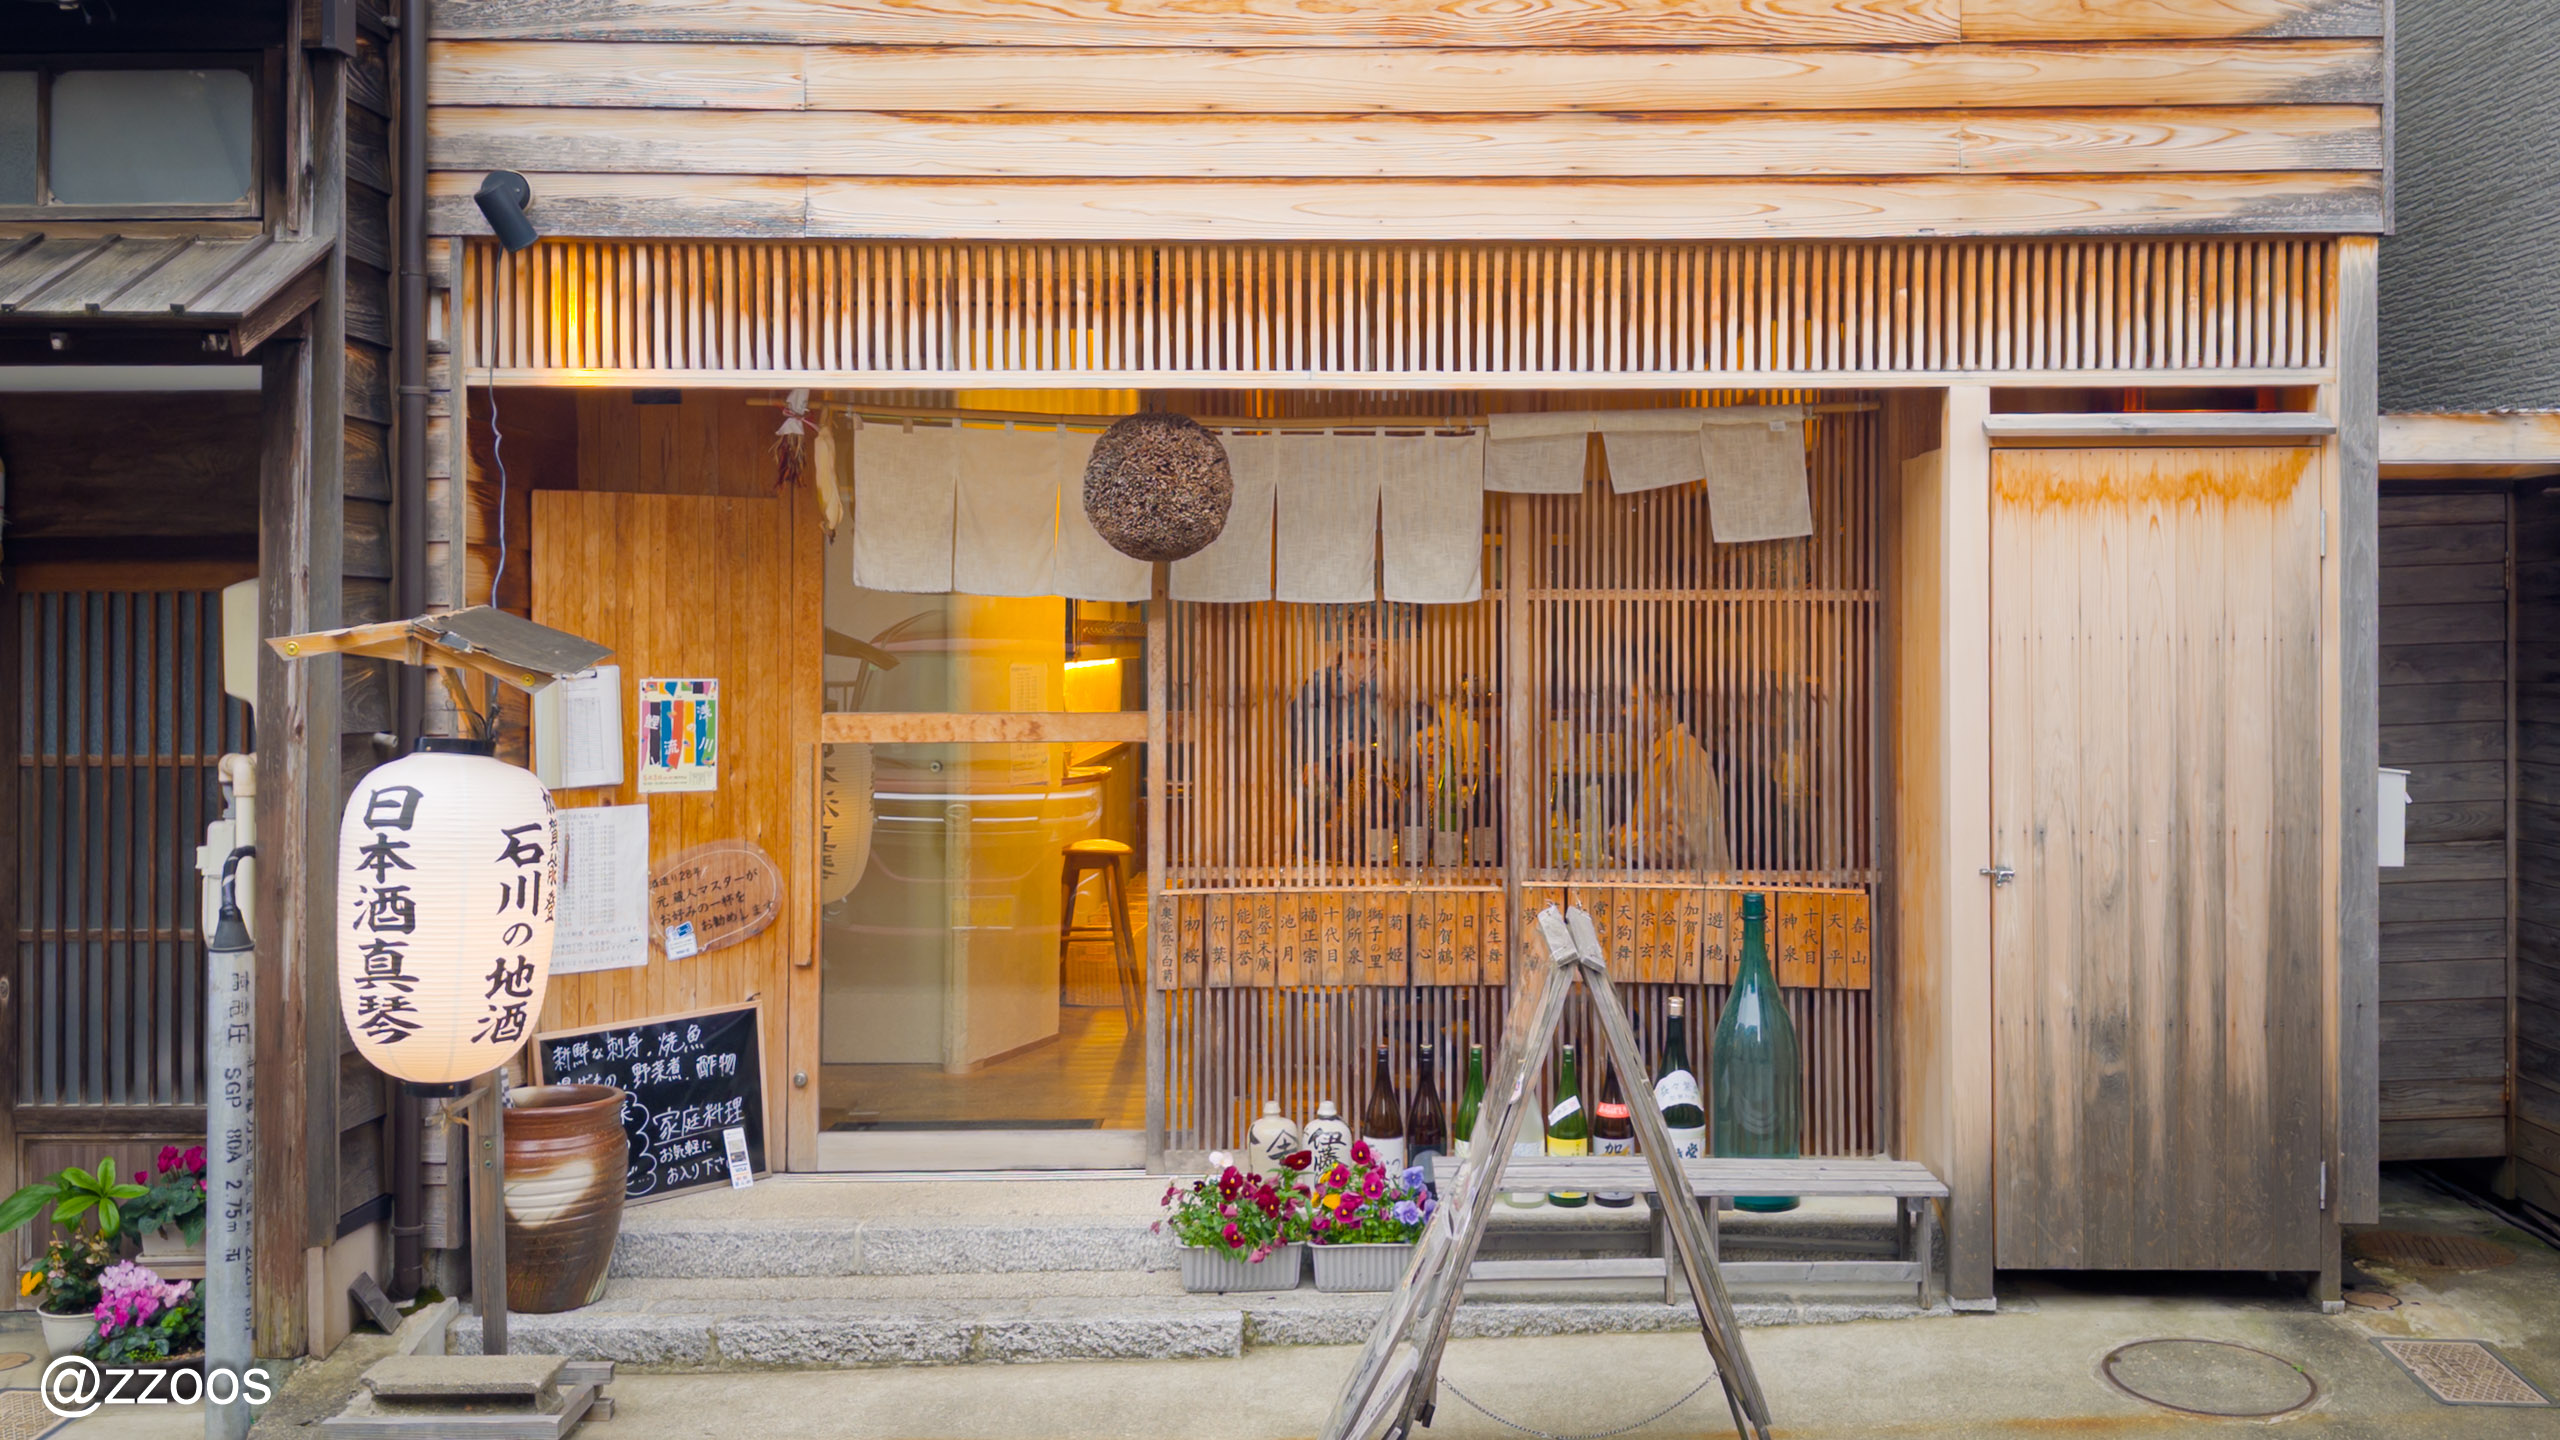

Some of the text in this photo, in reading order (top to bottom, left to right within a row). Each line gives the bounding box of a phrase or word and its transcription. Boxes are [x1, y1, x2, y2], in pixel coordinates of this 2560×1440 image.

[471, 822, 545, 1044] 石川の地酒
[1212, 915, 1228, 964] 竹葉
[1280, 914, 1297, 963] 池月
[1301, 907, 1319, 964] 福正宗
[1324, 906, 1340, 964] 十代目
[1367, 908, 1384, 969] 獅子の里
[1387, 914, 1404, 962] 菊姫
[1437, 908, 1454, 965] 加賀鶴
[1615, 904, 1633, 961] 天狗舞
[1639, 910, 1656, 958] 宗玄
[1658, 910, 1677, 959] 谷泉
[1682, 902, 1699, 967] 加賀ノ月
[1781, 912, 1799, 963] 神泉
[1803, 908, 1819, 965] 十代目
[1826, 913, 1843, 965] 天平
[1851, 916, 1867, 966] 春山
[224, 1067, 243, 1108] SGP
[652, 1096, 745, 1141] 家庭料理
[225, 1129, 243, 1163] 80A
[659, 1139, 713, 1163] お気軽に
[667, 1156, 729, 1185] お入り下さ
